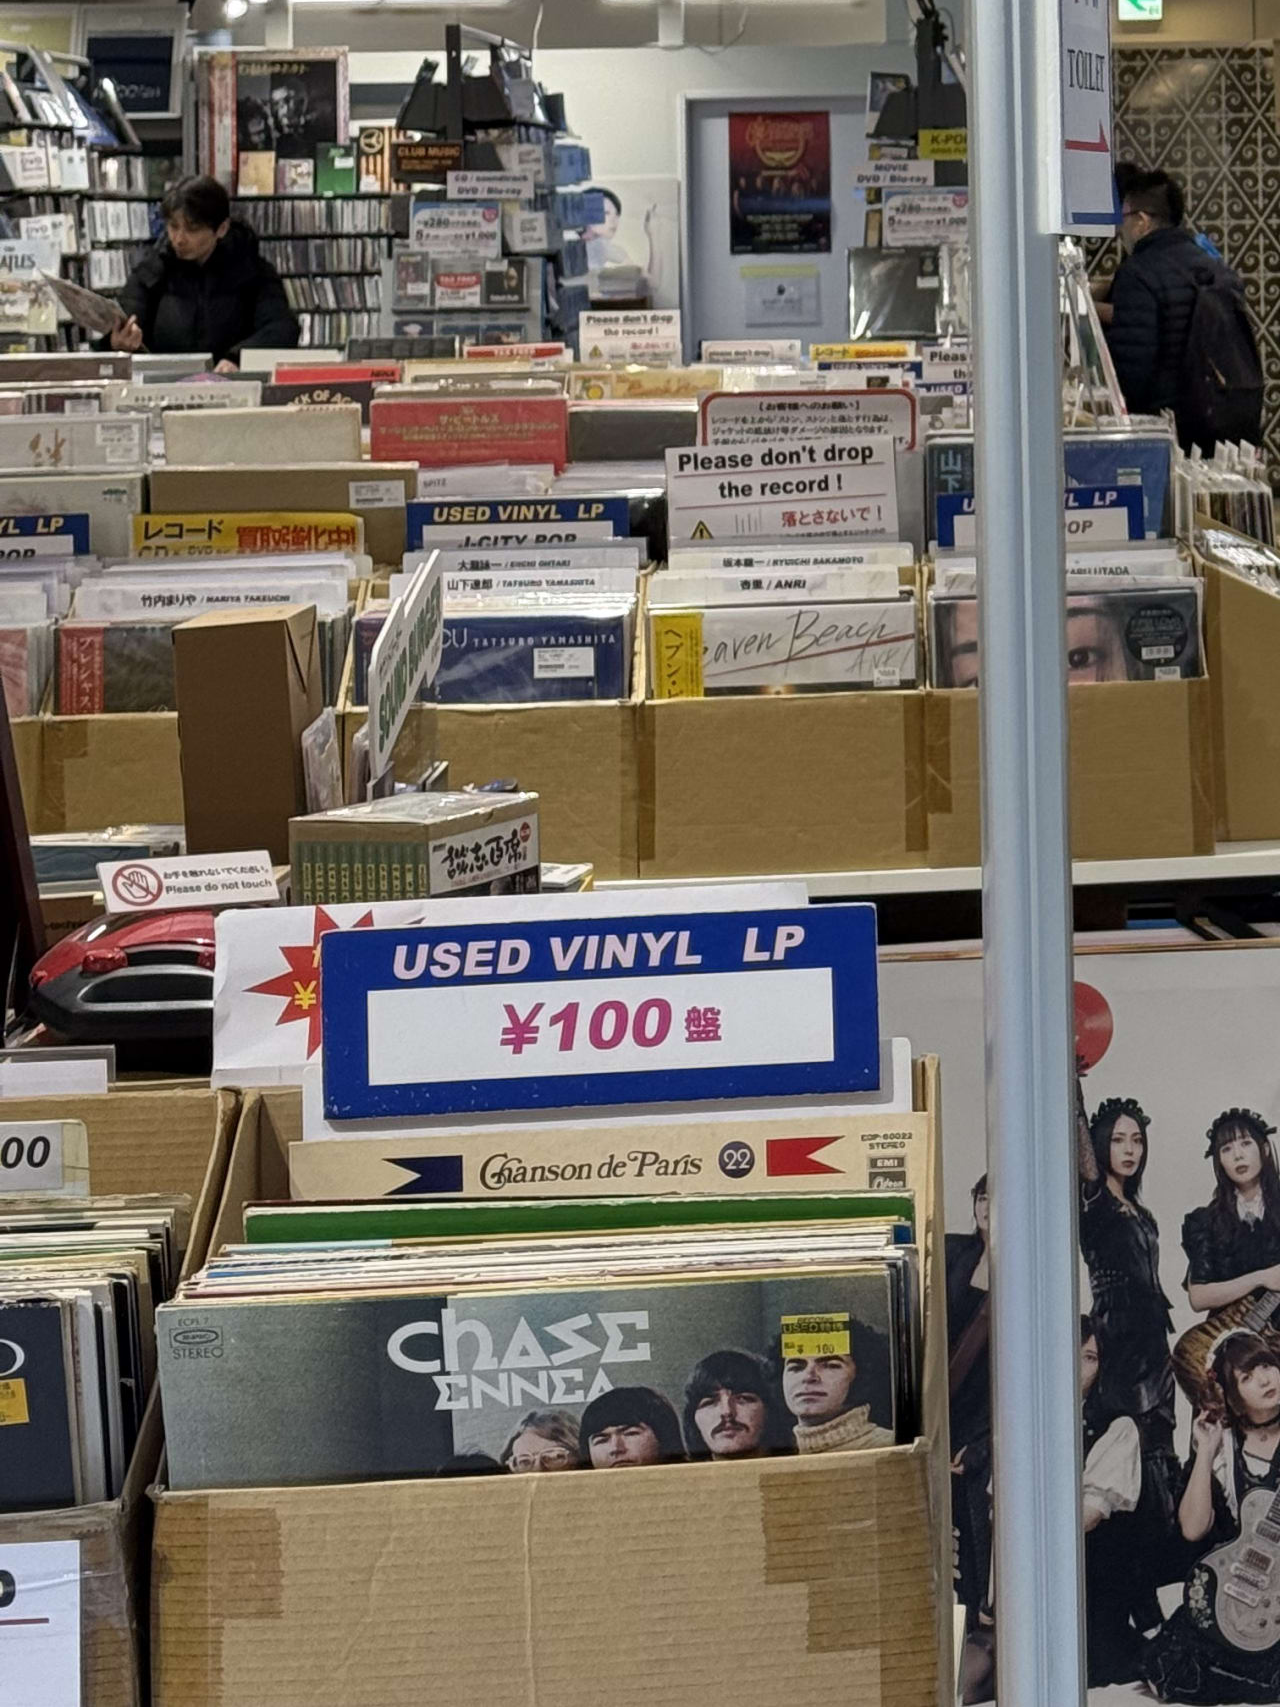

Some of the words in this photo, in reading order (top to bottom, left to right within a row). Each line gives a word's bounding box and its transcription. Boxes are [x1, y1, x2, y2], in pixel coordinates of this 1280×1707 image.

[1066, 48, 1105, 93] TOILET
[397, 145, 427, 158] CLUB
[428, 146, 461, 158] MUSIC
[874, 163, 909, 172] MOVIE
[929, 350, 968, 362] Pleas
[677, 450, 754, 473] Please
[760, 445, 817, 467] don't
[823, 443, 874, 465] drop
[718, 480, 753, 499] the
[760, 474, 830, 496] record
[835, 473, 843, 491] !
[1092, 490, 1118, 506] LP
[432, 506, 491, 523] USED
[497, 505, 563, 521] VINYL
[577, 503, 605, 519] LP
[781, 505, 883, 528] 落とさないで！
[36, 516, 65, 534] LP
[143, 518, 225, 541] レコード
[774, 579, 807, 590] ANRI
[472, 636, 535, 648] TATSURO
[541, 633, 616, 645] YAMASHITA
[786, 607, 898, 678] Beach
[165, 884, 202, 895] Please
[204, 882, 219, 892] do
[221, 881, 239, 891] not
[241, 878, 273, 890] touch
[392, 939, 532, 980] USED
[549, 929, 703, 972] VINYL
[741, 924, 806, 964] LP
[501, 997, 673, 1055] ¥100
[684, 1005, 723, 1044] 盤
[868, 1141, 906, 1150] STEREO
[722, 1148, 752, 1171] 22
[876, 1158, 899, 1167] EMI
[479, 1152, 591, 1192] Chanson
[596, 1154, 628, 1179] de
[627, 1149, 704, 1179] Paris
[172, 1346, 225, 1360] STEREO
[431, 1366, 616, 1411] ENNEA
